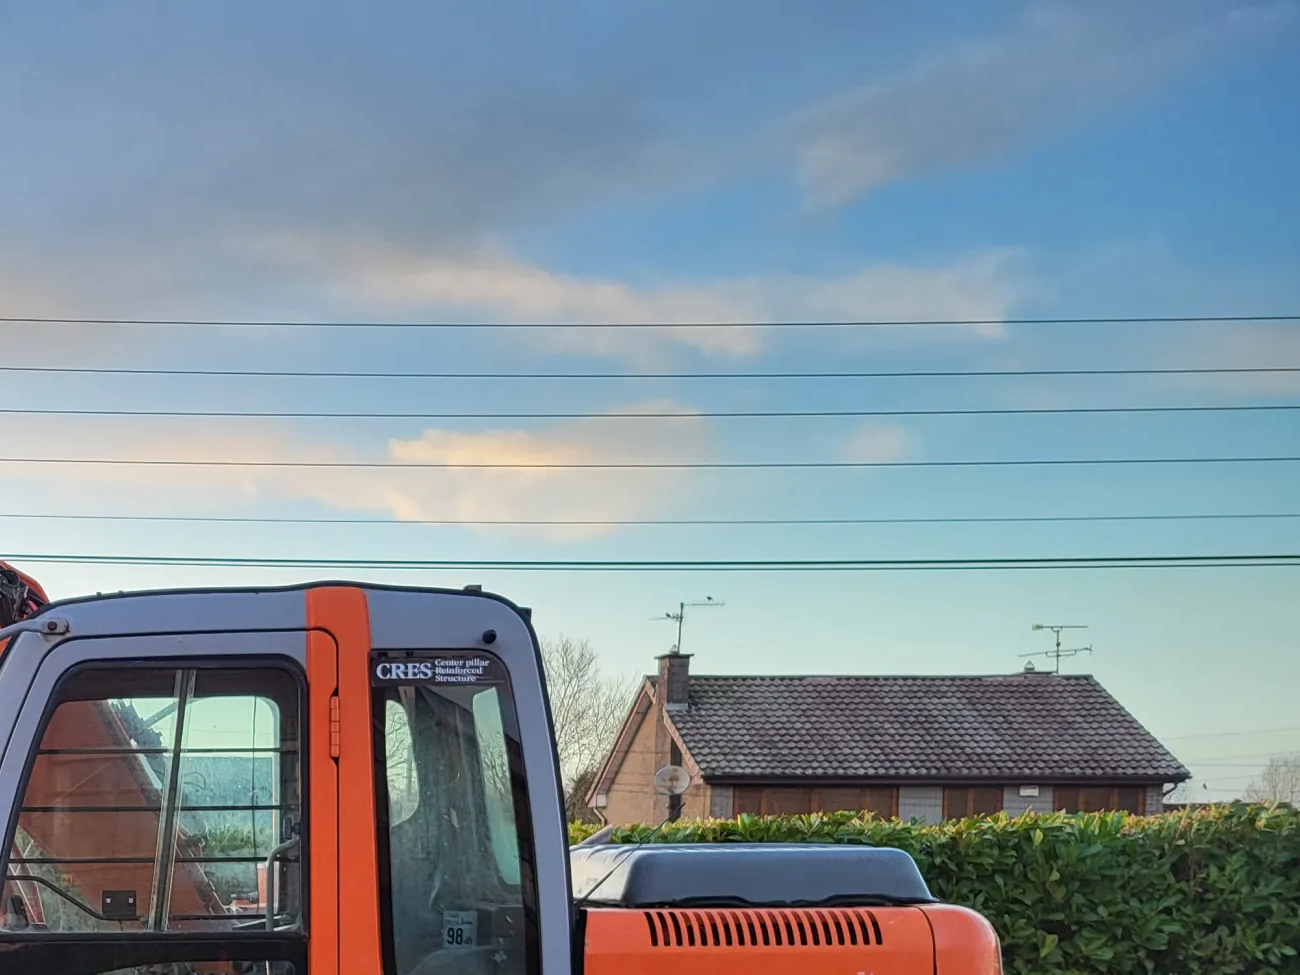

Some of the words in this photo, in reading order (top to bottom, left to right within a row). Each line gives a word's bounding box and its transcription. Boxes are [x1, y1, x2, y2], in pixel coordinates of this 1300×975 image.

[434, 659, 464, 667] Center
[465, 658, 490, 668] pillar
[376, 662, 432, 680] CRES
[435, 666, 483, 674] Reinforced
[434, 674, 476, 682] Structure
[446, 927, 463, 945] 98
